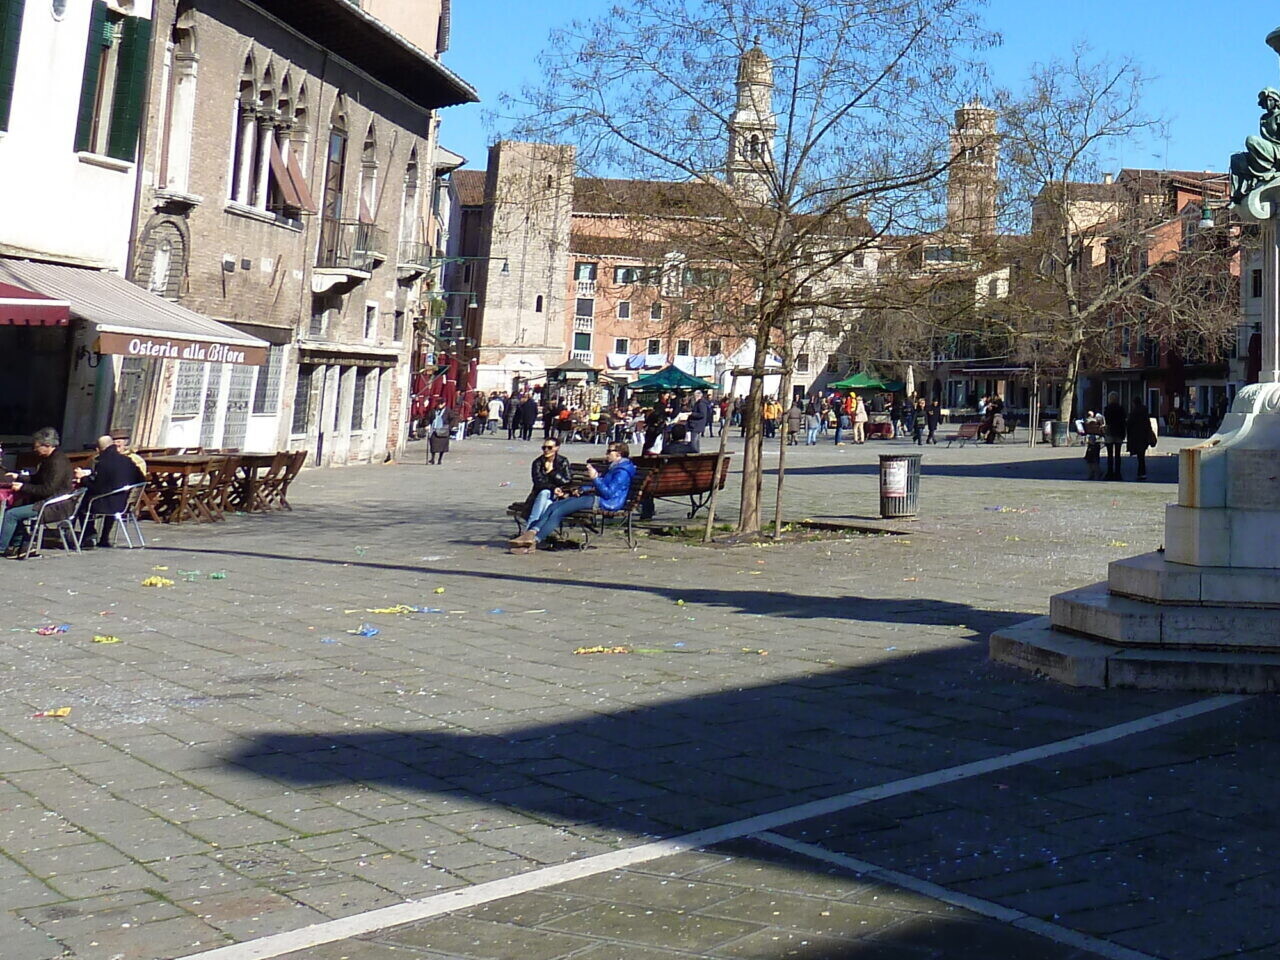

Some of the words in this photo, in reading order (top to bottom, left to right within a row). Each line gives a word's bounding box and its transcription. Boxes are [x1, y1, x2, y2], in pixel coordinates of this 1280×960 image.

[129, 339, 178, 357] Osteria
[183, 342, 205, 360] alla
[207, 343, 245, 363] Bifora
